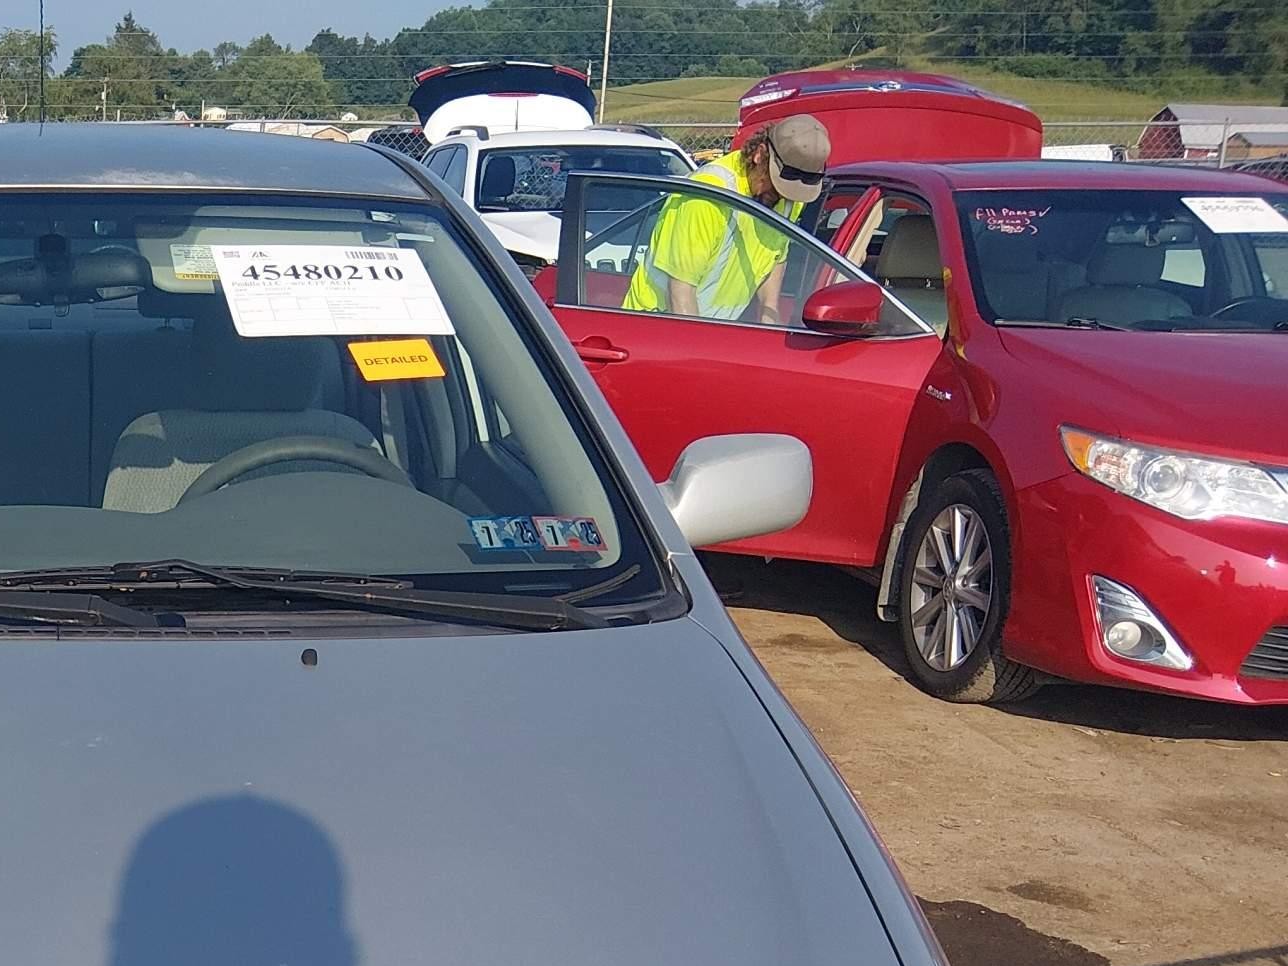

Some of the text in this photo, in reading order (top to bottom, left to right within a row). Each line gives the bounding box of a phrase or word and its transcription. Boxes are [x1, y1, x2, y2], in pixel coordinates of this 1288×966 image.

[242, 264, 404, 281] 45480210
[363, 354, 428, 366] DETAILED
[514, 520, 537, 544] 25
[579, 521, 602, 545] 25
